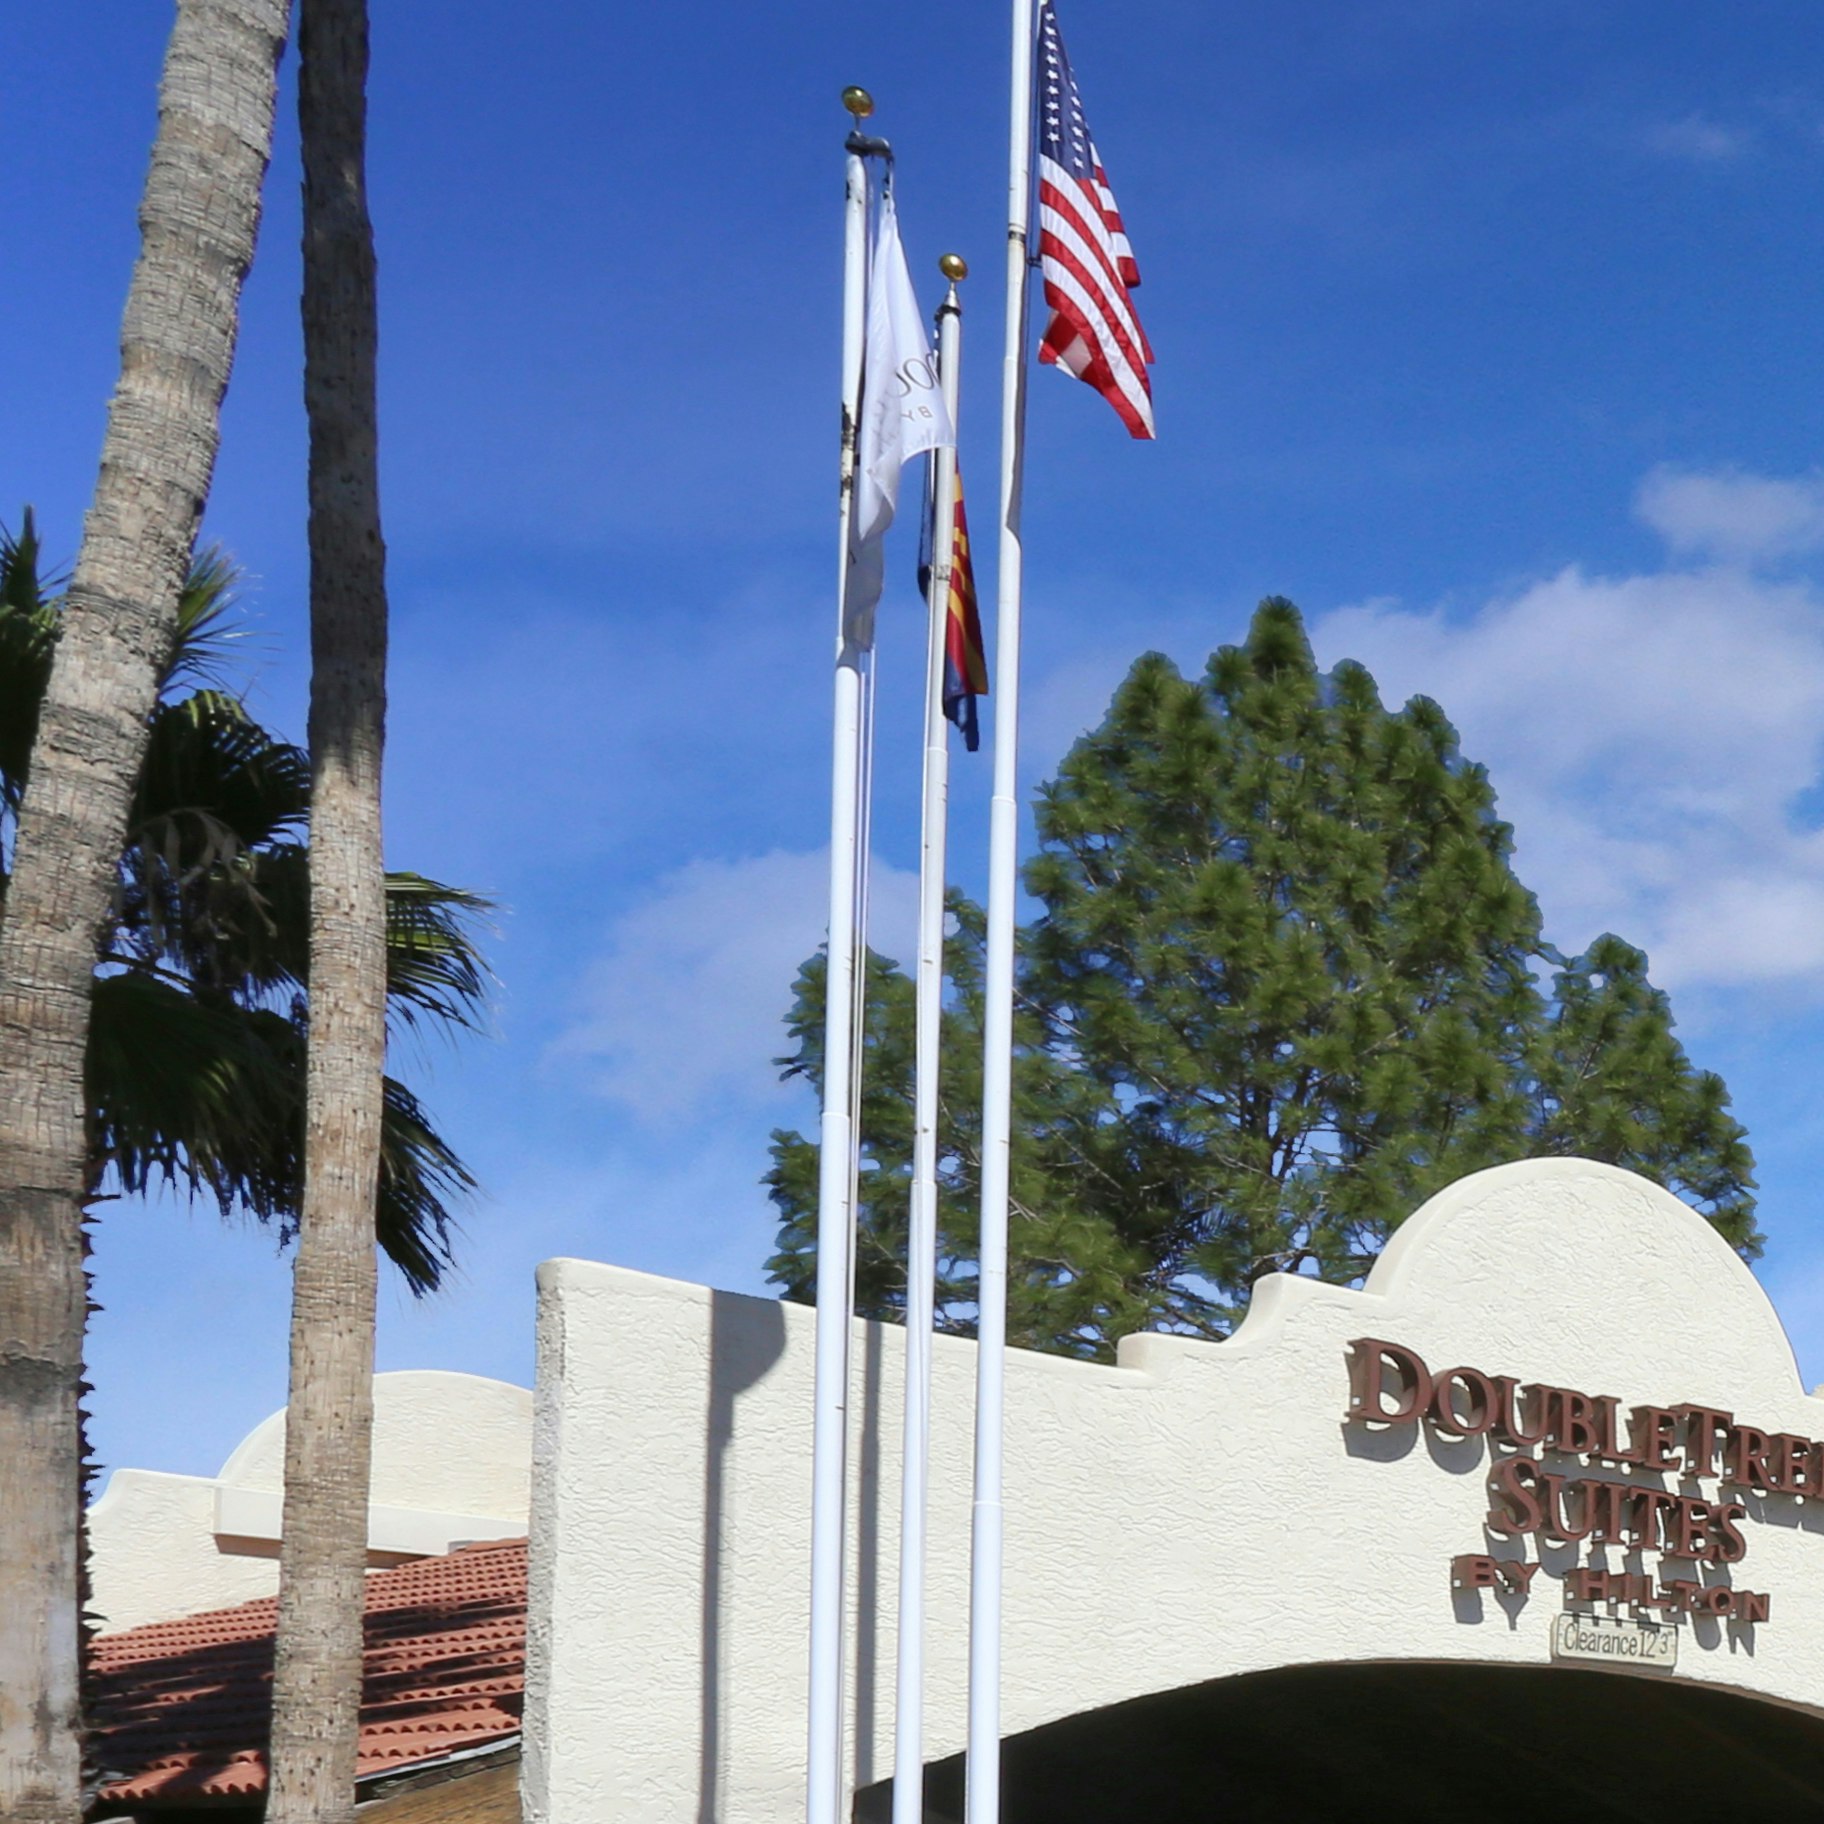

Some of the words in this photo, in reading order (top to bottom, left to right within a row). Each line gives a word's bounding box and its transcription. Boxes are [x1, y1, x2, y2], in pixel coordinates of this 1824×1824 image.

[1488, 1456, 1746, 1563] SUITES
[1451, 1554, 1541, 1594] BY
[1564, 1568, 1770, 1622] HILTON
[1564, 1622, 1638, 1656] Clearance
